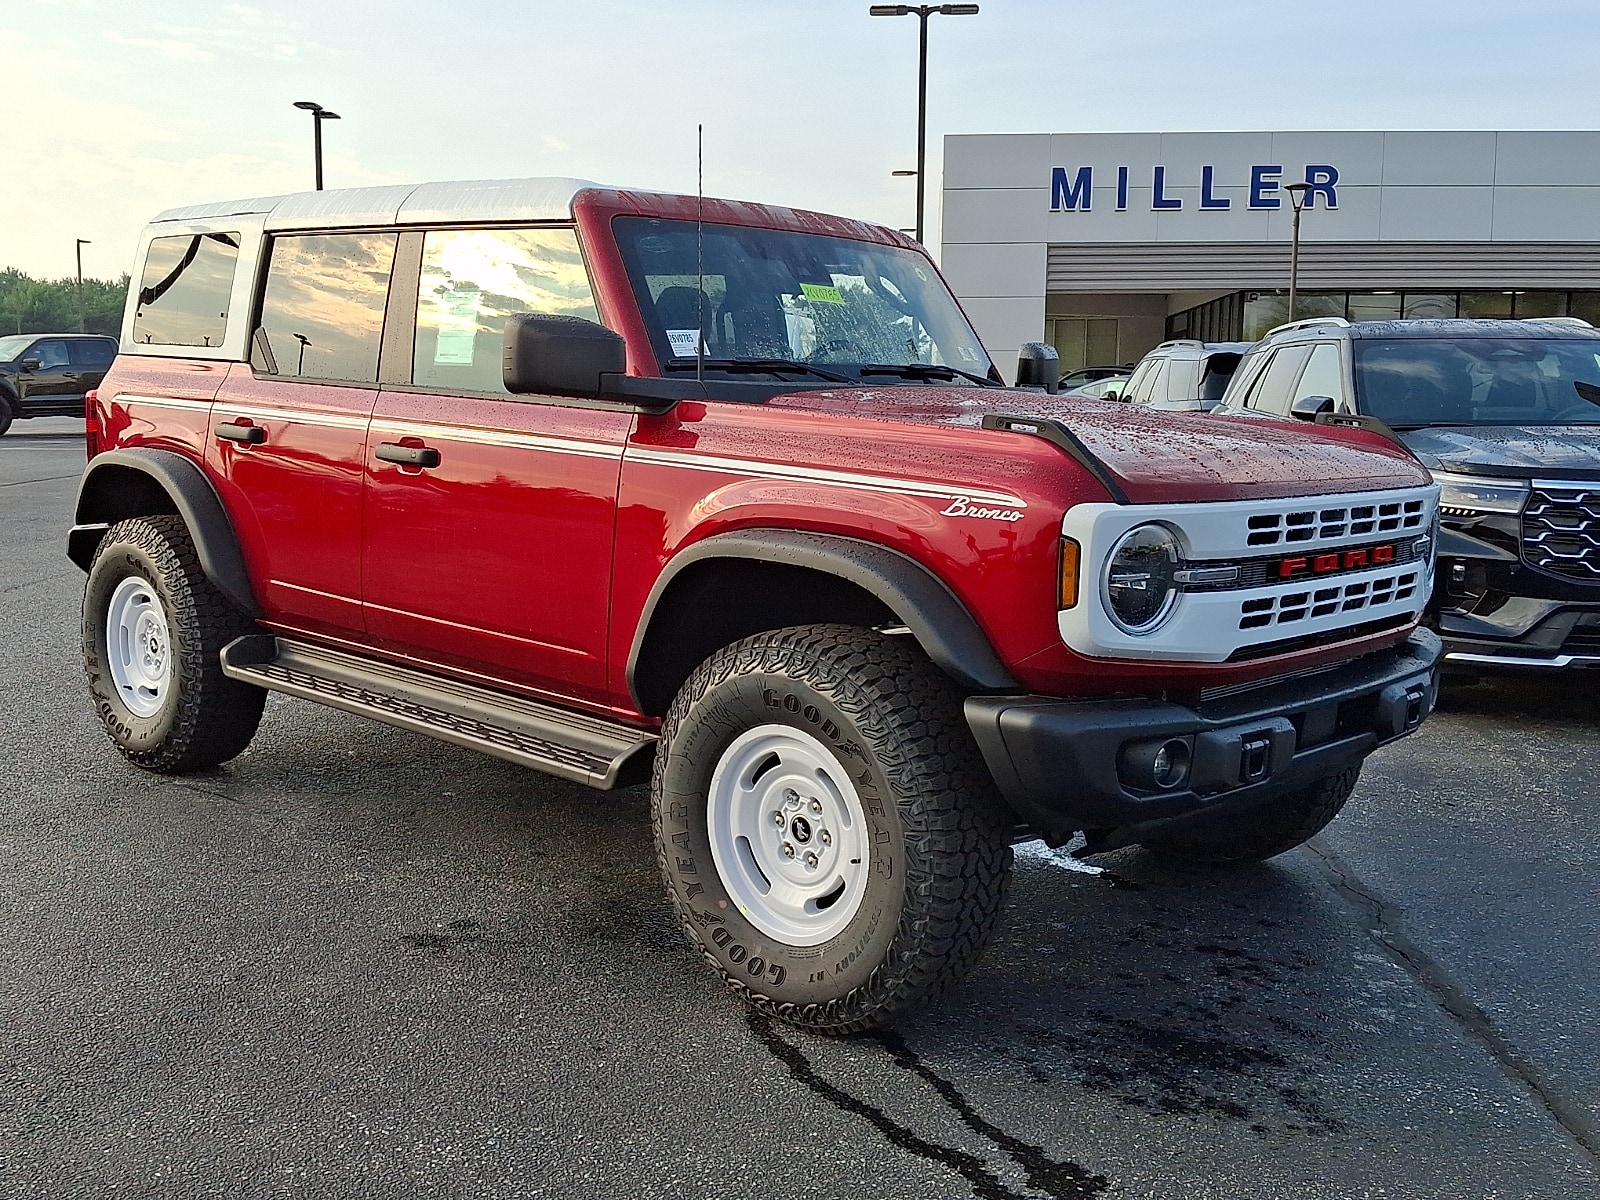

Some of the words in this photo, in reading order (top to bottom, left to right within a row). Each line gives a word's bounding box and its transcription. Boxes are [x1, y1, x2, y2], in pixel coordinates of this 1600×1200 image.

[1049, 164, 1341, 211] MILLER
[939, 495, 1025, 522] Bronco
[1279, 545, 1393, 577] FORD
